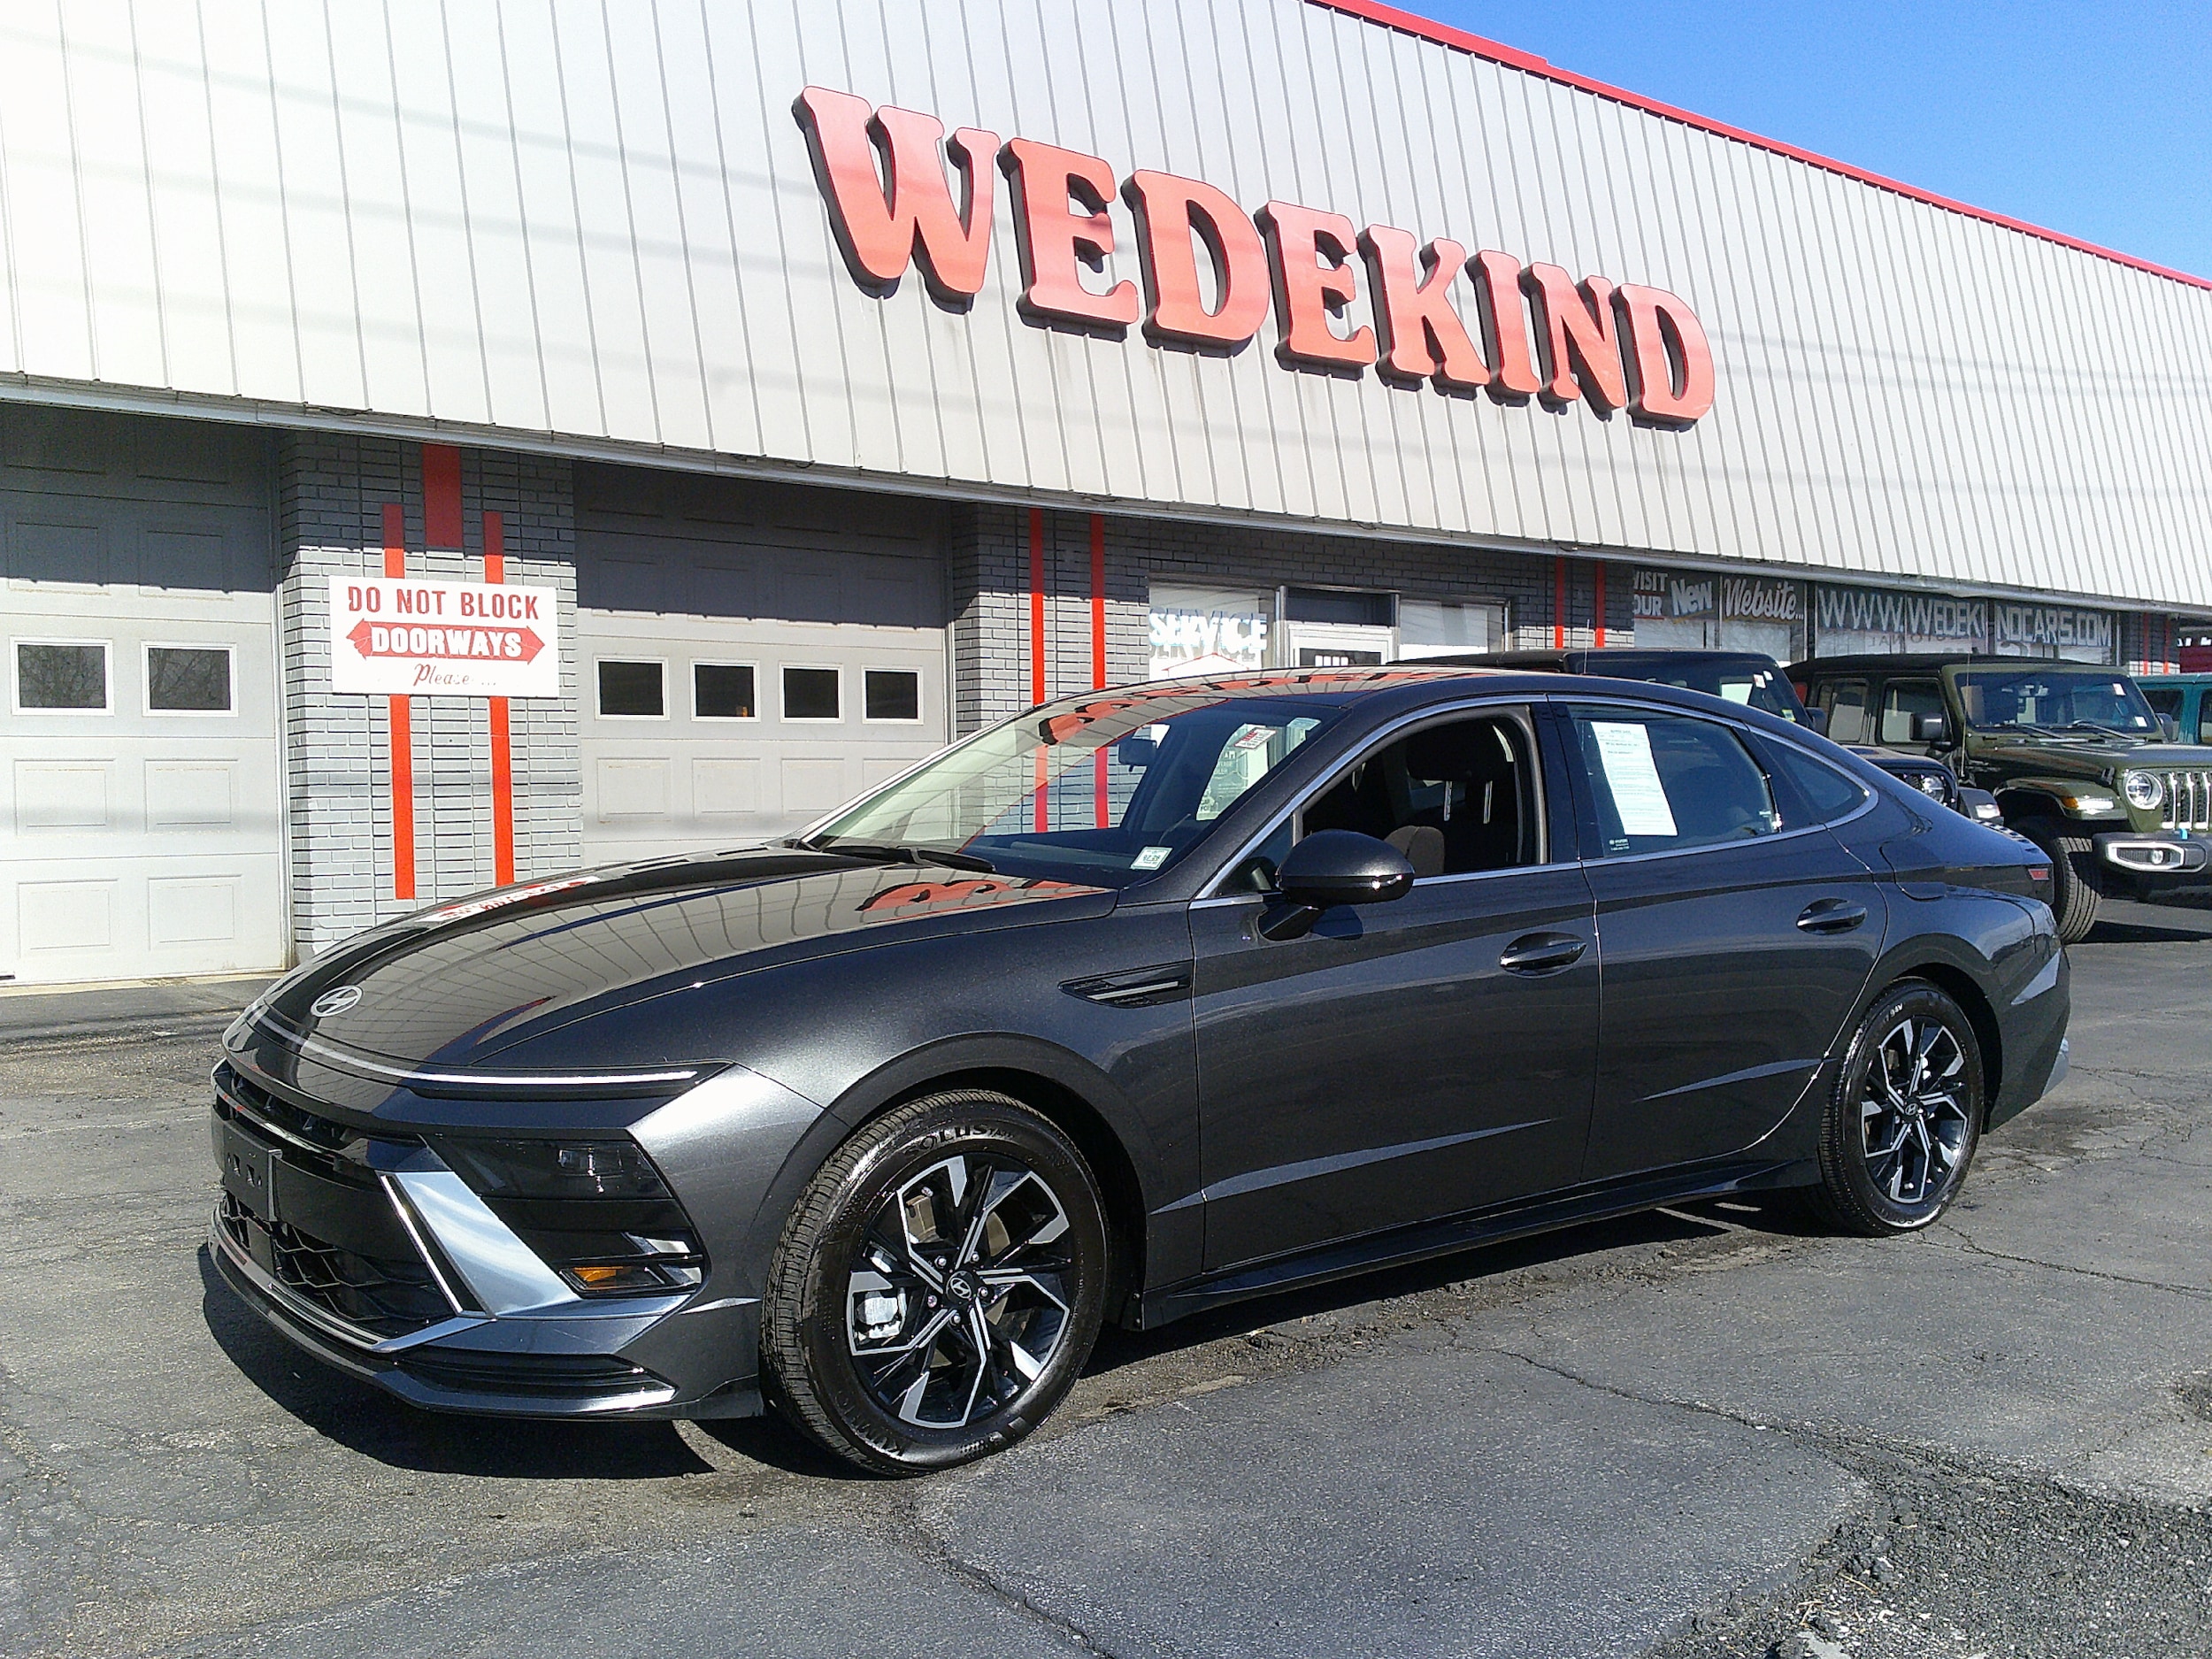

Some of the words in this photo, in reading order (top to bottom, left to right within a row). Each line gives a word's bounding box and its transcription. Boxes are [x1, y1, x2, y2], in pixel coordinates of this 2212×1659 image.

[794, 86, 1715, 431] WEDEKIND
[348, 586, 381, 613] DO
[396, 588, 446, 615] NOT
[460, 592, 539, 619] BLOCK
[1671, 579, 1713, 616] New
[371, 626, 523, 658] DOORWAYS
[1148, 609, 1268, 653] SERVICE
